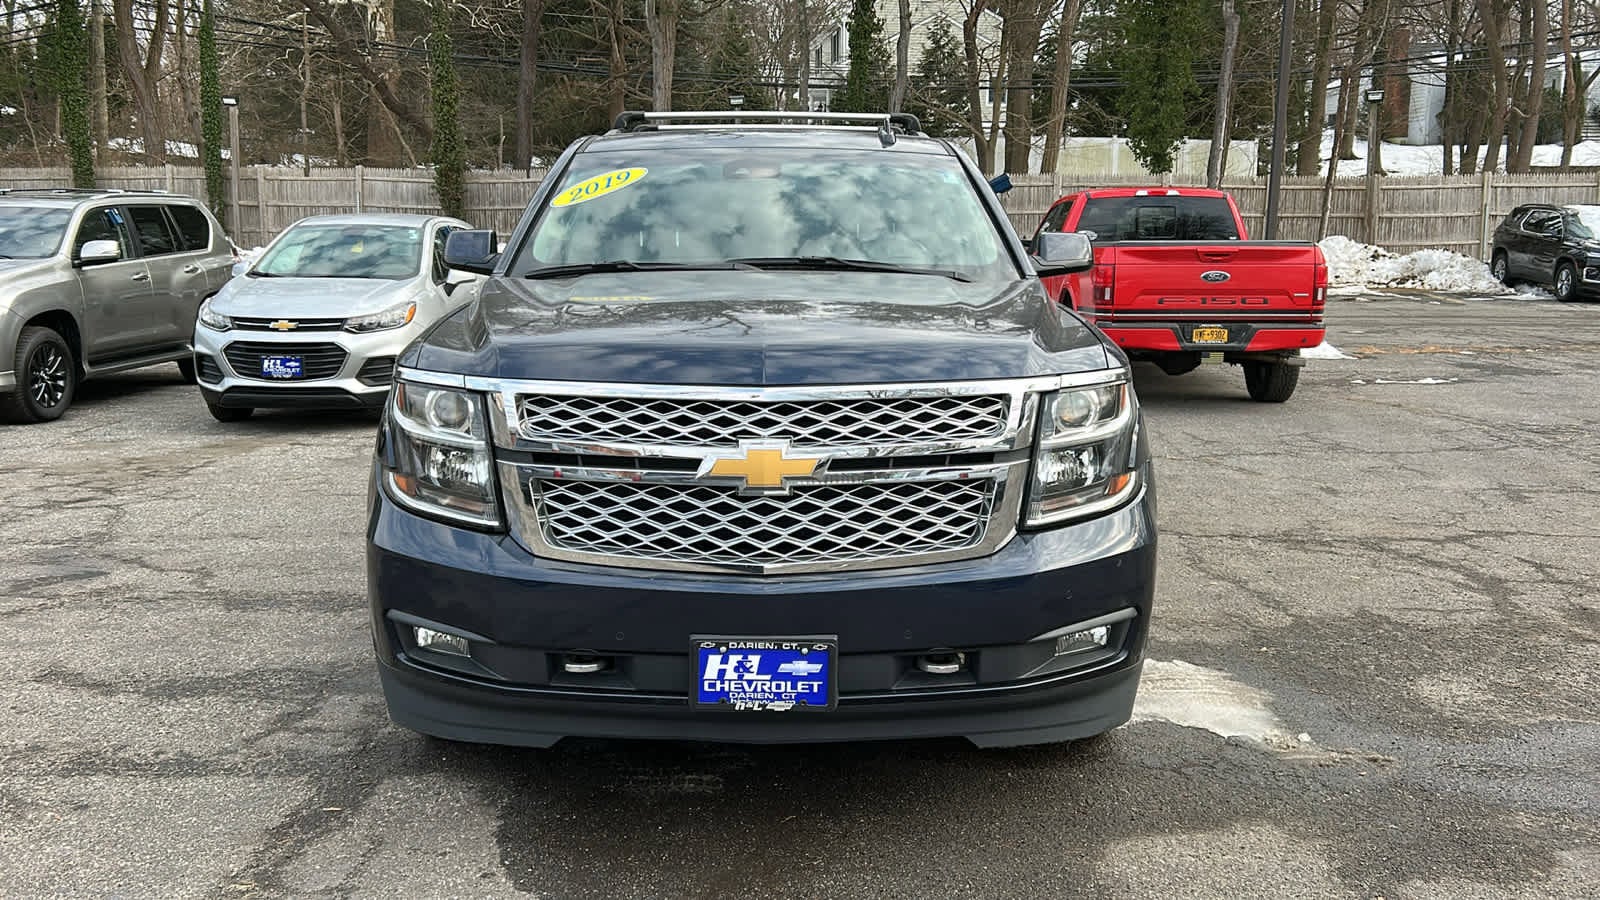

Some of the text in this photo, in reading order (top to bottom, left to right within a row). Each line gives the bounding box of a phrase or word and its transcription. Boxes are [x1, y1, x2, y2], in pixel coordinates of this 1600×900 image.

[570, 171, 631, 202] 2019
[703, 654, 772, 680] H&L
[703, 680, 823, 693] CHEVROLET
[782, 692, 797, 700] CT
